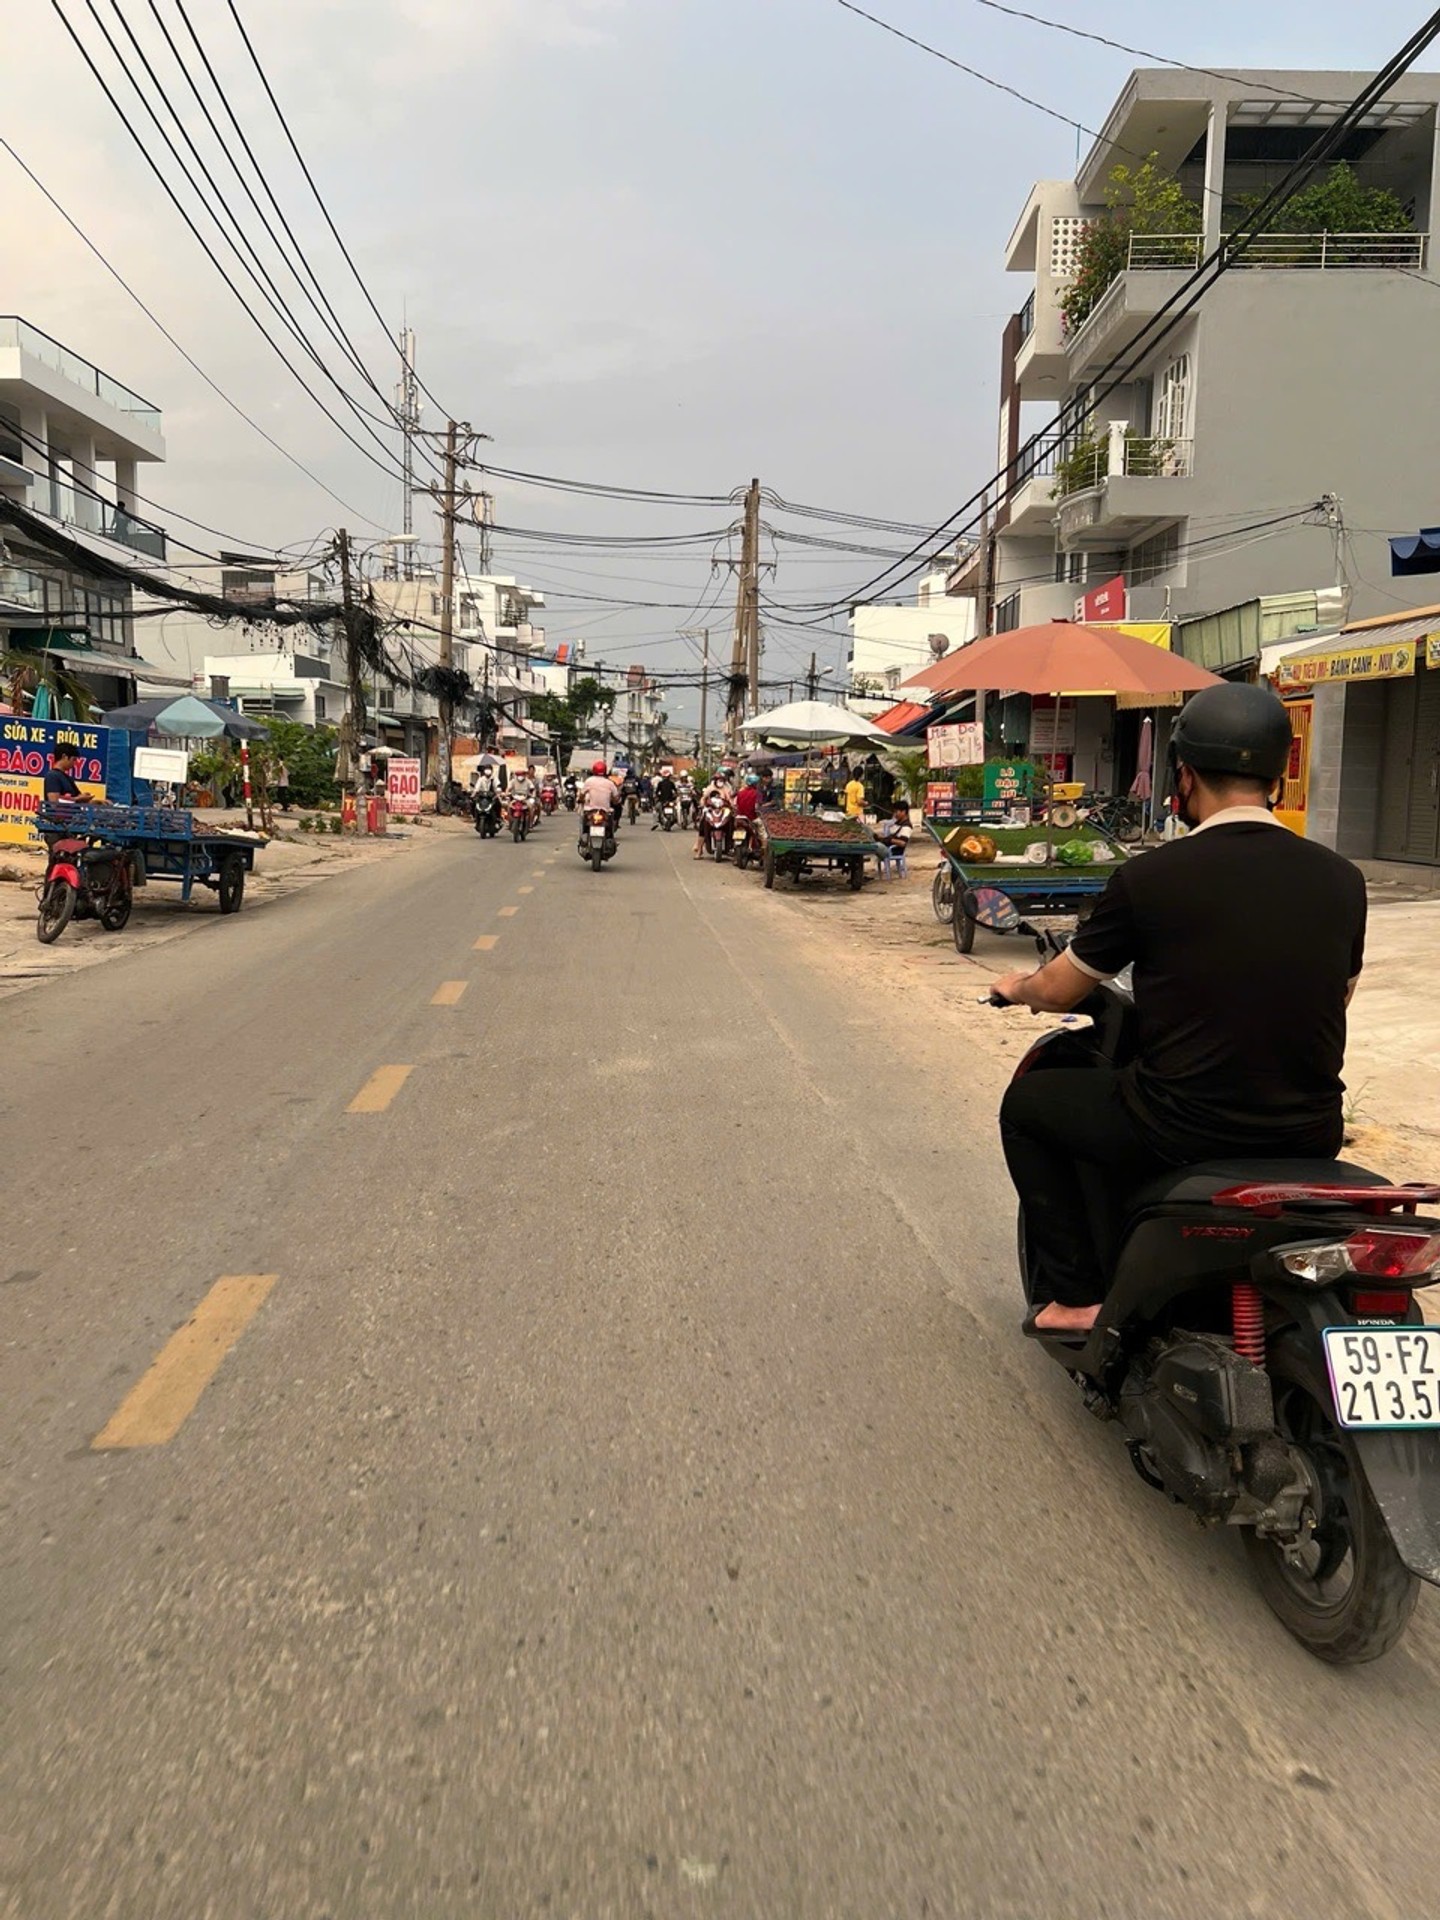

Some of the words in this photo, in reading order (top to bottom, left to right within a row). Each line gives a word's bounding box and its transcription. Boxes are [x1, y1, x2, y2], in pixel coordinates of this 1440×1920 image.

[1351, 655, 1372, 675] CANH
[4, 720, 28, 741] SỬA
[31, 727, 46, 743] XE
[83, 733, 98, 749] XE
[0, 745, 44, 775] BẢO
[88, 759, 102, 781] 2
[389, 774, 418, 798] GẠO
[1343, 1335, 1434, 1375] 59-F2
